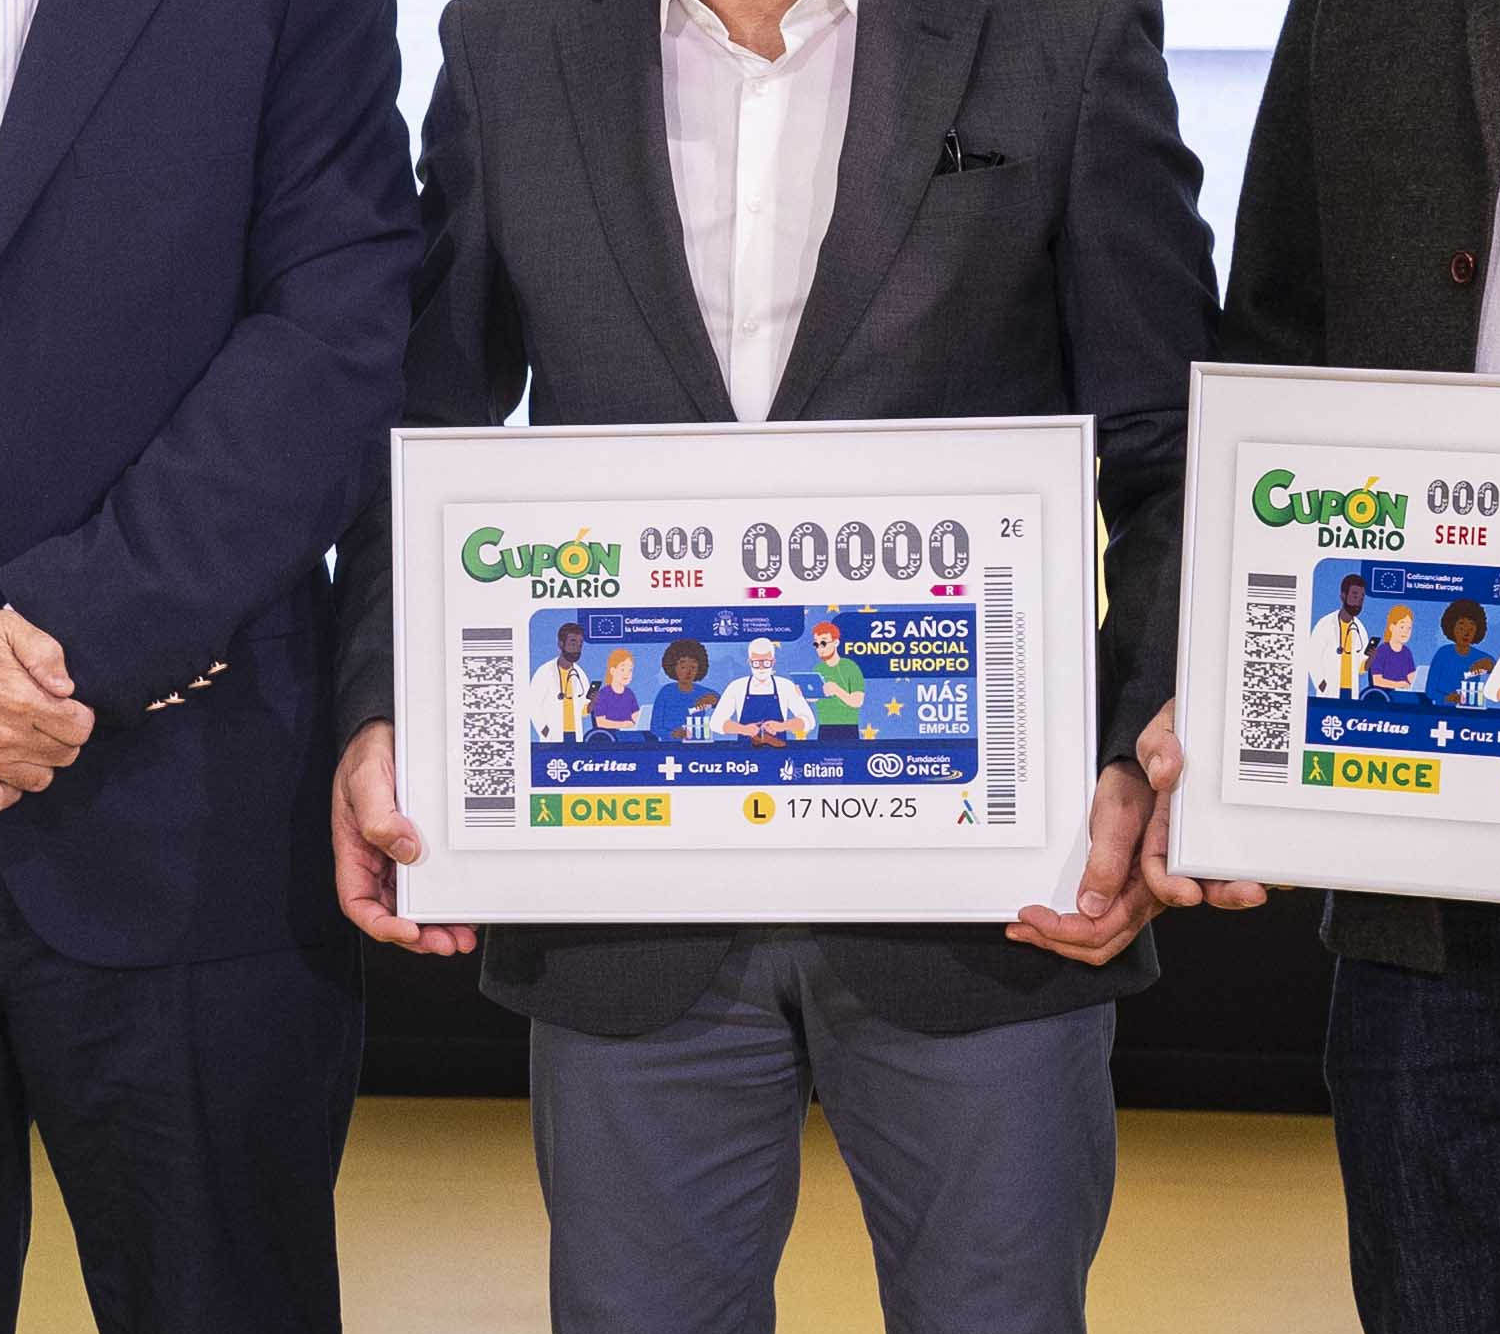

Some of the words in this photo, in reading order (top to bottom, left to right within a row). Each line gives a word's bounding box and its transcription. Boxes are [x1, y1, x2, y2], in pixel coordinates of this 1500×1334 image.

[1000, 517, 1024, 537] 2€
[1435, 525, 1487, 546] SERIE
[650, 569, 703, 588] SERIE
[870, 620, 895, 638] 25
[903, 615, 968, 638] AÑOS
[844, 641, 905, 655] FONDO
[910, 640, 968, 654] SOCIAL
[889, 657, 969, 671] EUROPEO
[916, 679, 967, 702] MÁS
[917, 703, 967, 722] QUE
[919, 723, 969, 734] EMPLEO
[1346, 718, 1409, 735] Cáritas
[1460, 728, 1493, 742] Cruz
[572, 759, 636, 772] Cáritas
[907, 754, 950, 763] Fundación
[688, 761, 722, 773] Cruz
[726, 761, 758, 775] Roja
[803, 762, 843, 777] Gitano
[906, 763, 950, 775] ONCE
[1341, 758, 1432, 787] ONCE
[570, 798, 662, 820] ONCE
[753, 799, 765, 818] L
[786, 798, 812, 818] 17
[822, 797, 883, 818] NOV.
[890, 798, 916, 817] 25
